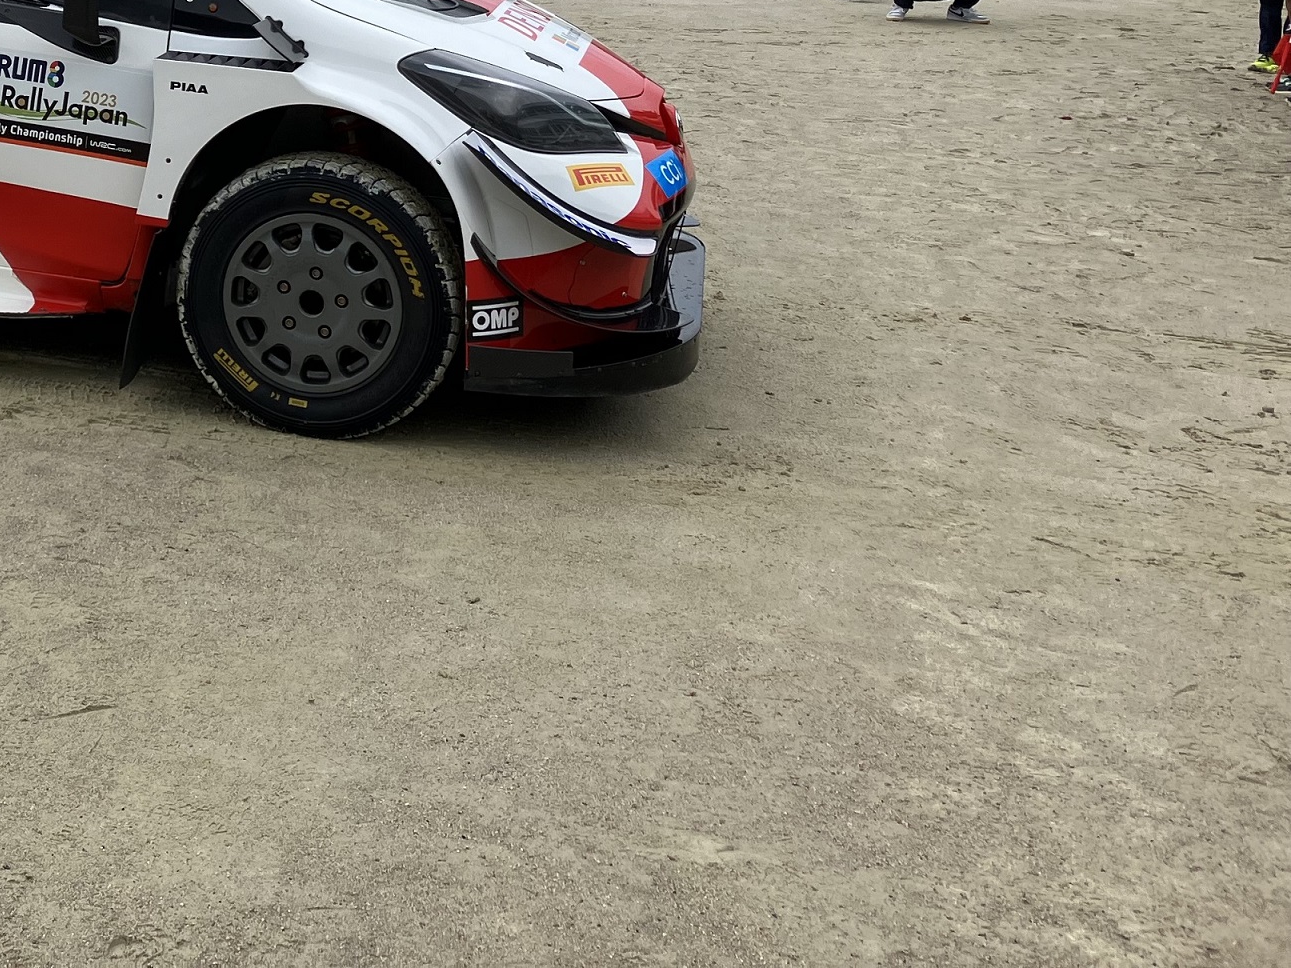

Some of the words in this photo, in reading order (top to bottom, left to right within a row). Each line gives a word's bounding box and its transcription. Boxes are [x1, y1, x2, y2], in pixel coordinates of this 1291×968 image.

[81, 90, 117, 108] 2023
[170, 81, 208, 94] PIAA
[10, 124, 83, 147] Championship
[573, 166, 629, 186] PIRELLI
[309, 191, 425, 299] SCORPION
[472, 307, 519, 330] OMP
[213, 348, 259, 392] PIRELLI
